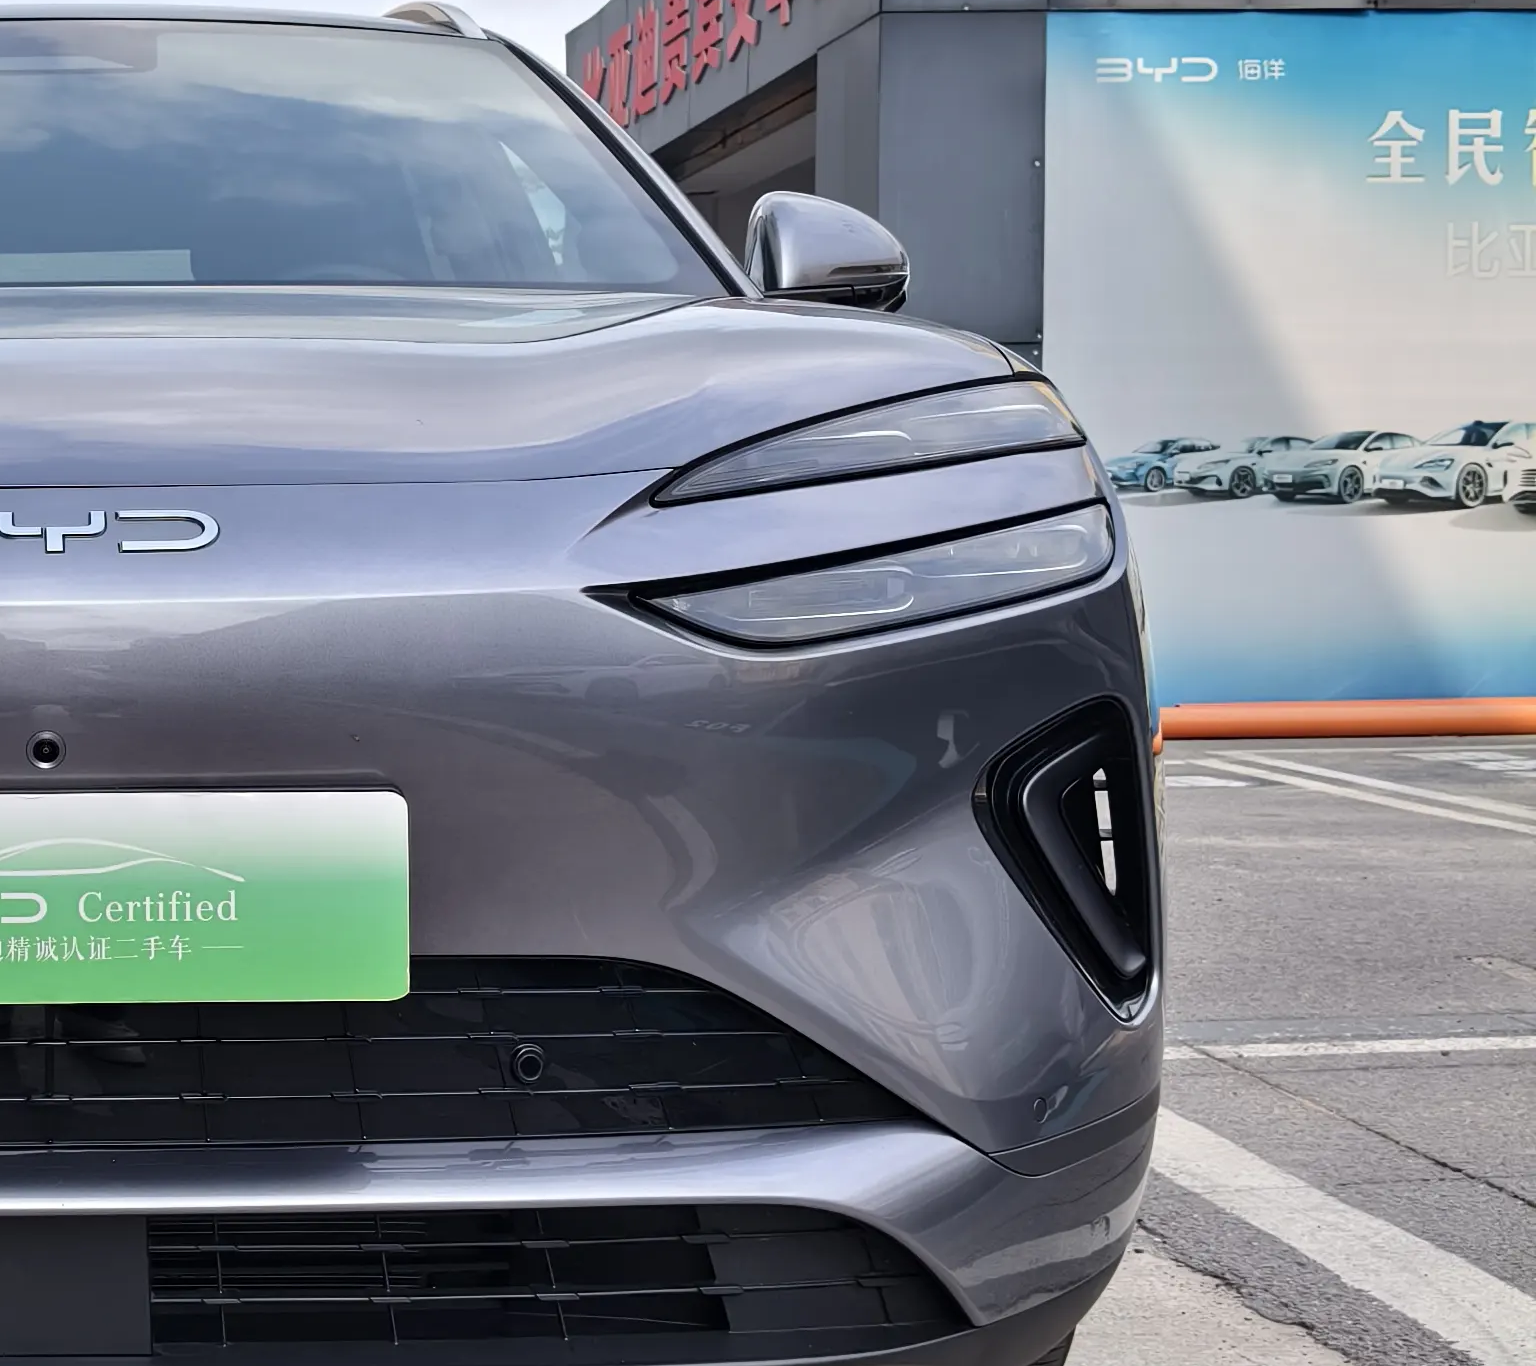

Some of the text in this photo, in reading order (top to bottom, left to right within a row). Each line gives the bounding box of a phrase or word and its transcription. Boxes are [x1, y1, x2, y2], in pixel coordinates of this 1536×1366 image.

[1096, 57, 1286, 83] BYD 海洋
[1366, 108, 1536, 186] 全民
[78, 890, 239, 923] Certified
